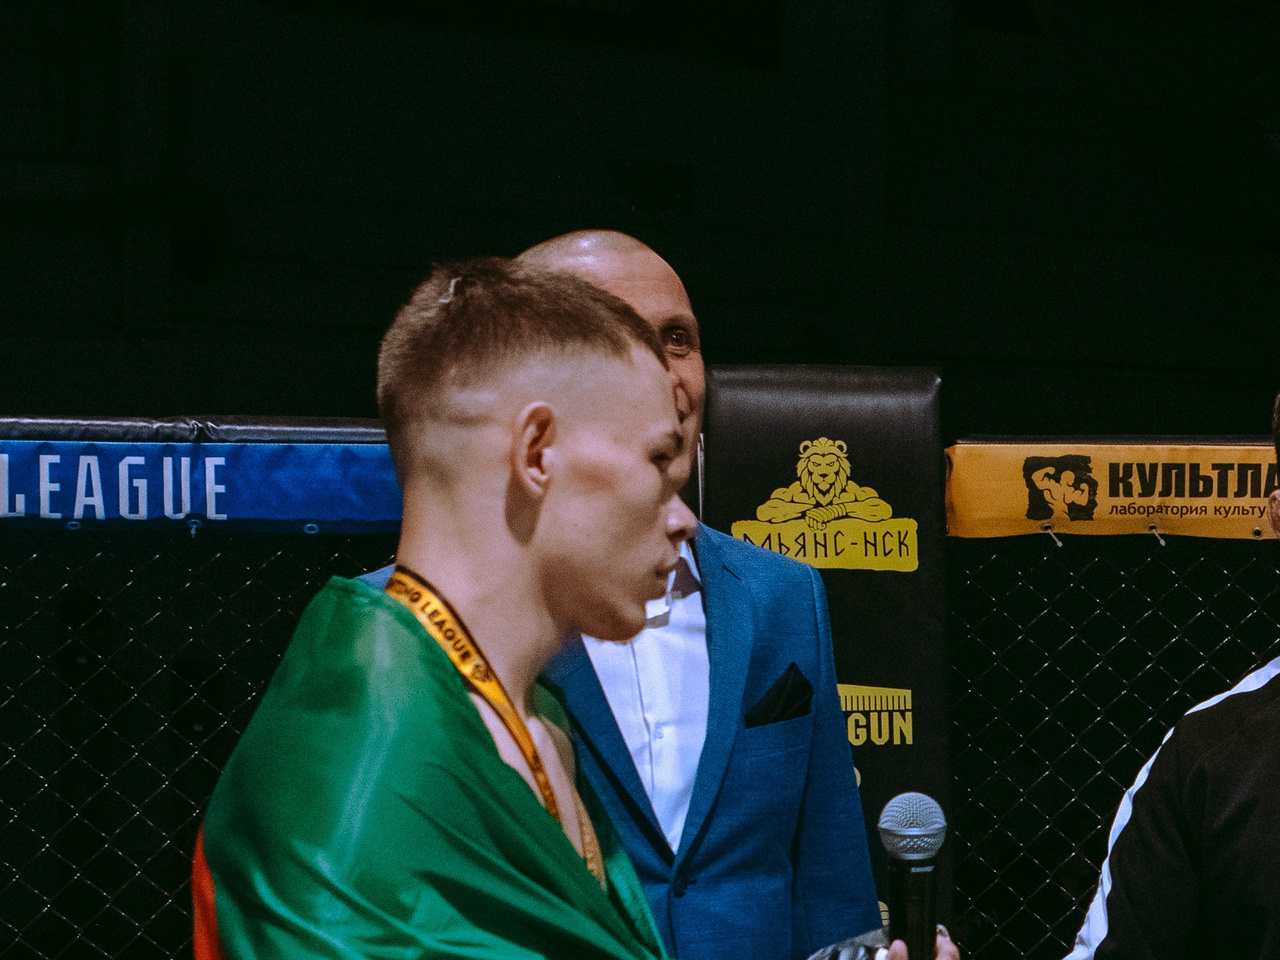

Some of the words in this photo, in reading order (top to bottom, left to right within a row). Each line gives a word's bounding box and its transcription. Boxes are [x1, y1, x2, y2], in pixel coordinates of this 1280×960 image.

[0, 453, 228, 521] LEAGUE
[1108, 502, 1207, 519] лаборатория
[847, 711, 914, 746] GUN
